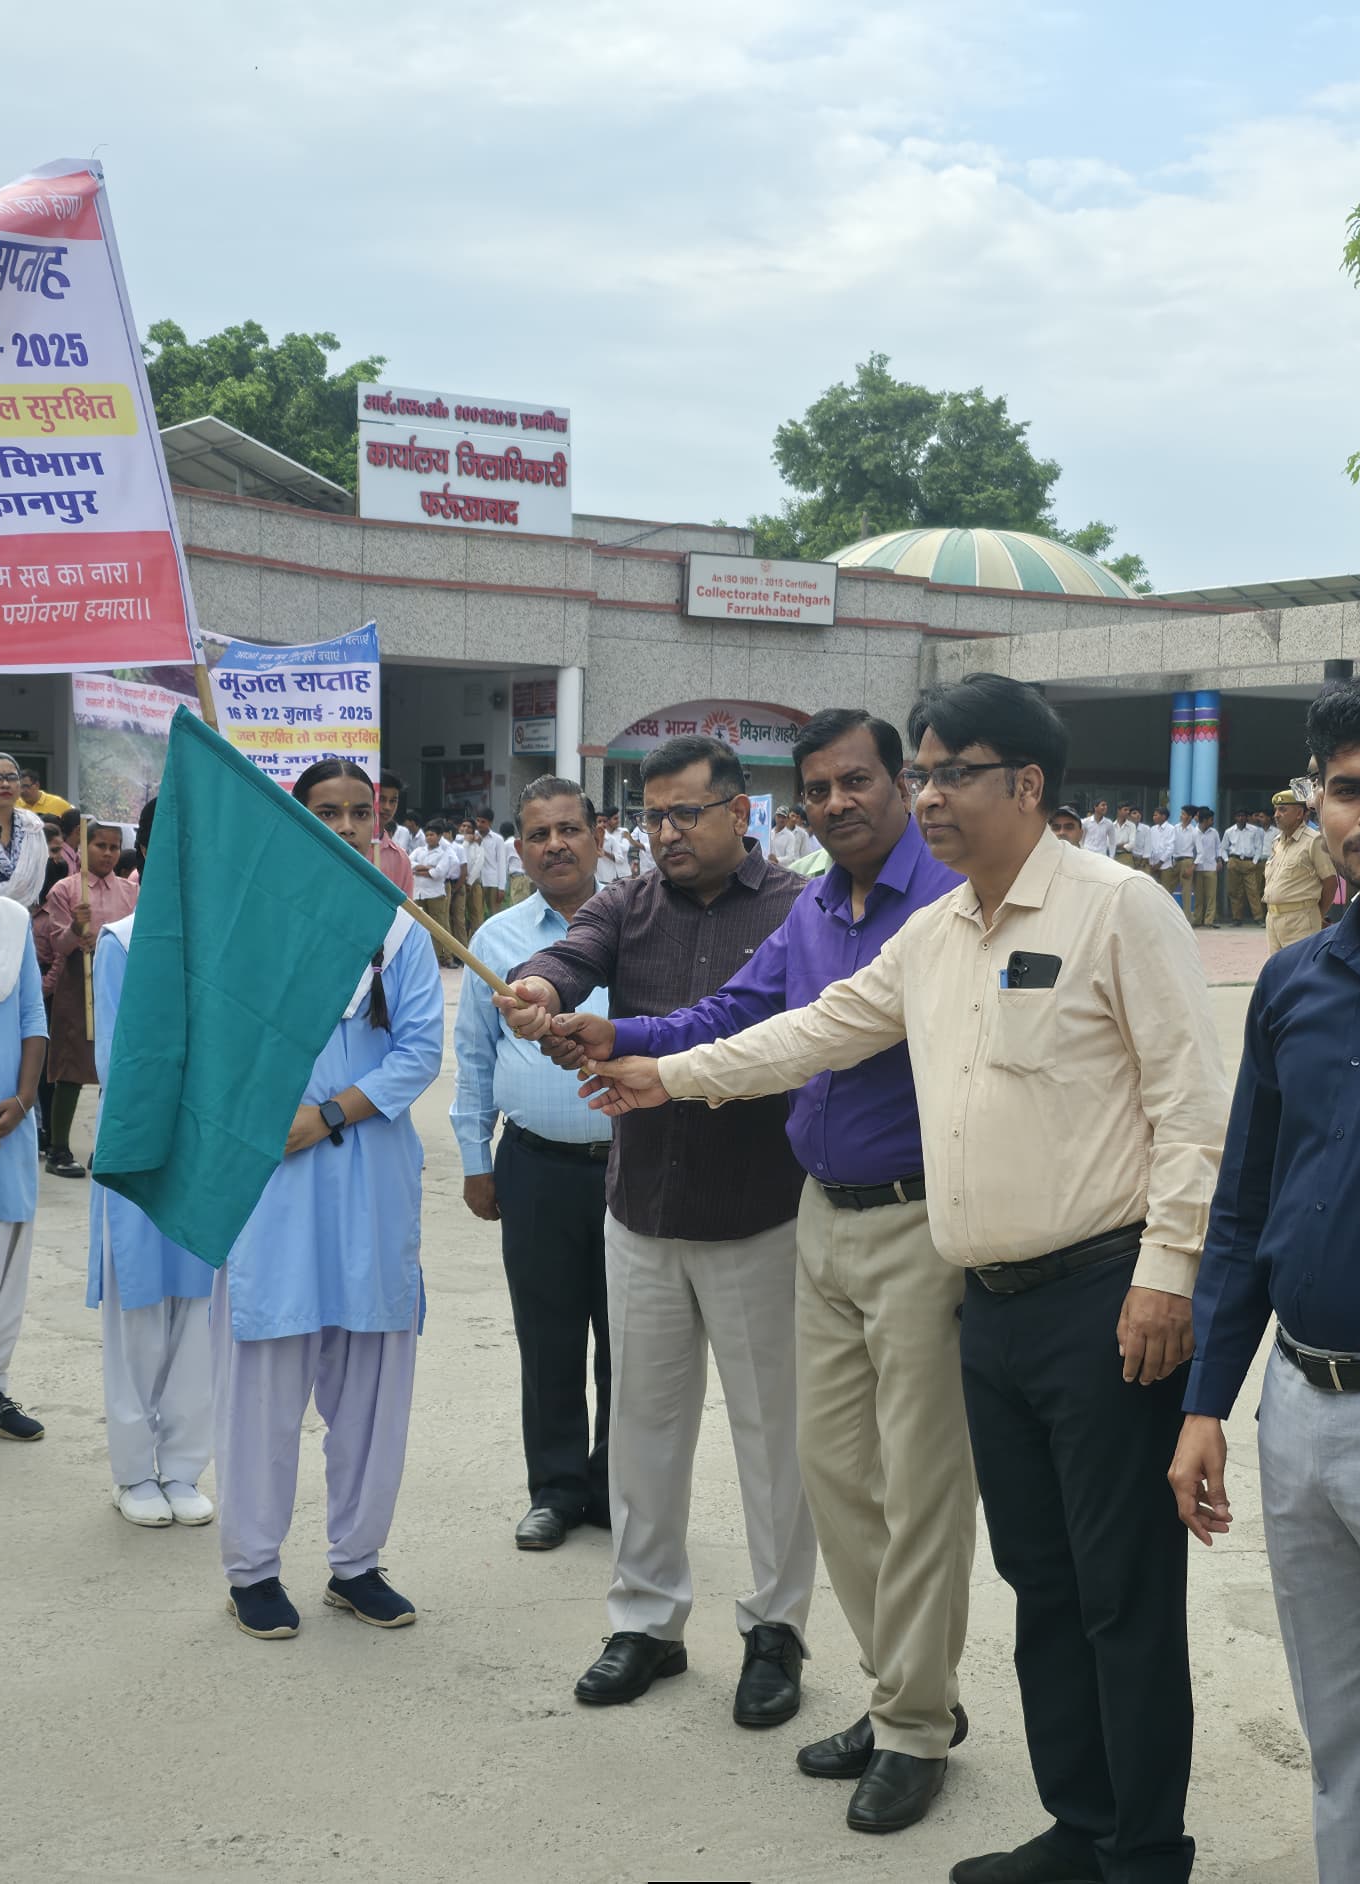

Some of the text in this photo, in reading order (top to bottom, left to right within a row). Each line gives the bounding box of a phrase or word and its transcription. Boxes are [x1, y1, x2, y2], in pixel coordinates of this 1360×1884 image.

[11, 333, 88, 367] 2025
[23, 386, 117, 432] सुरक्षित
[366, 435, 568, 487] कार्यालय जिलाधिकारी
[18, 565, 49, 588] सब
[55, 563, 85, 586] का
[87, 561, 129, 586] नारा
[724, 575, 737, 584] ISO
[765, 578, 783, 588] 2015
[785, 579, 817, 590] Certified
[696, 586, 831, 607] Collectorate Fatehgarh
[2, 595, 78, 626] पर्यावरण
[726, 602, 800, 618] Farrukhabad
[219, 671, 286, 699] भूजल
[291, 670, 371, 693] सप्ताह
[226, 706, 240, 720] 16
[244, 704, 257, 720] से
[261, 707, 279, 720] 22
[282, 704, 323, 725] जुलाई
[339, 706, 373, 720] 2025
[237, 728, 379, 748] जल सुरक्षित तो कल सुरक्षित
[665, 720, 697, 736] भारत
[740, 718, 772, 742] मिशन
